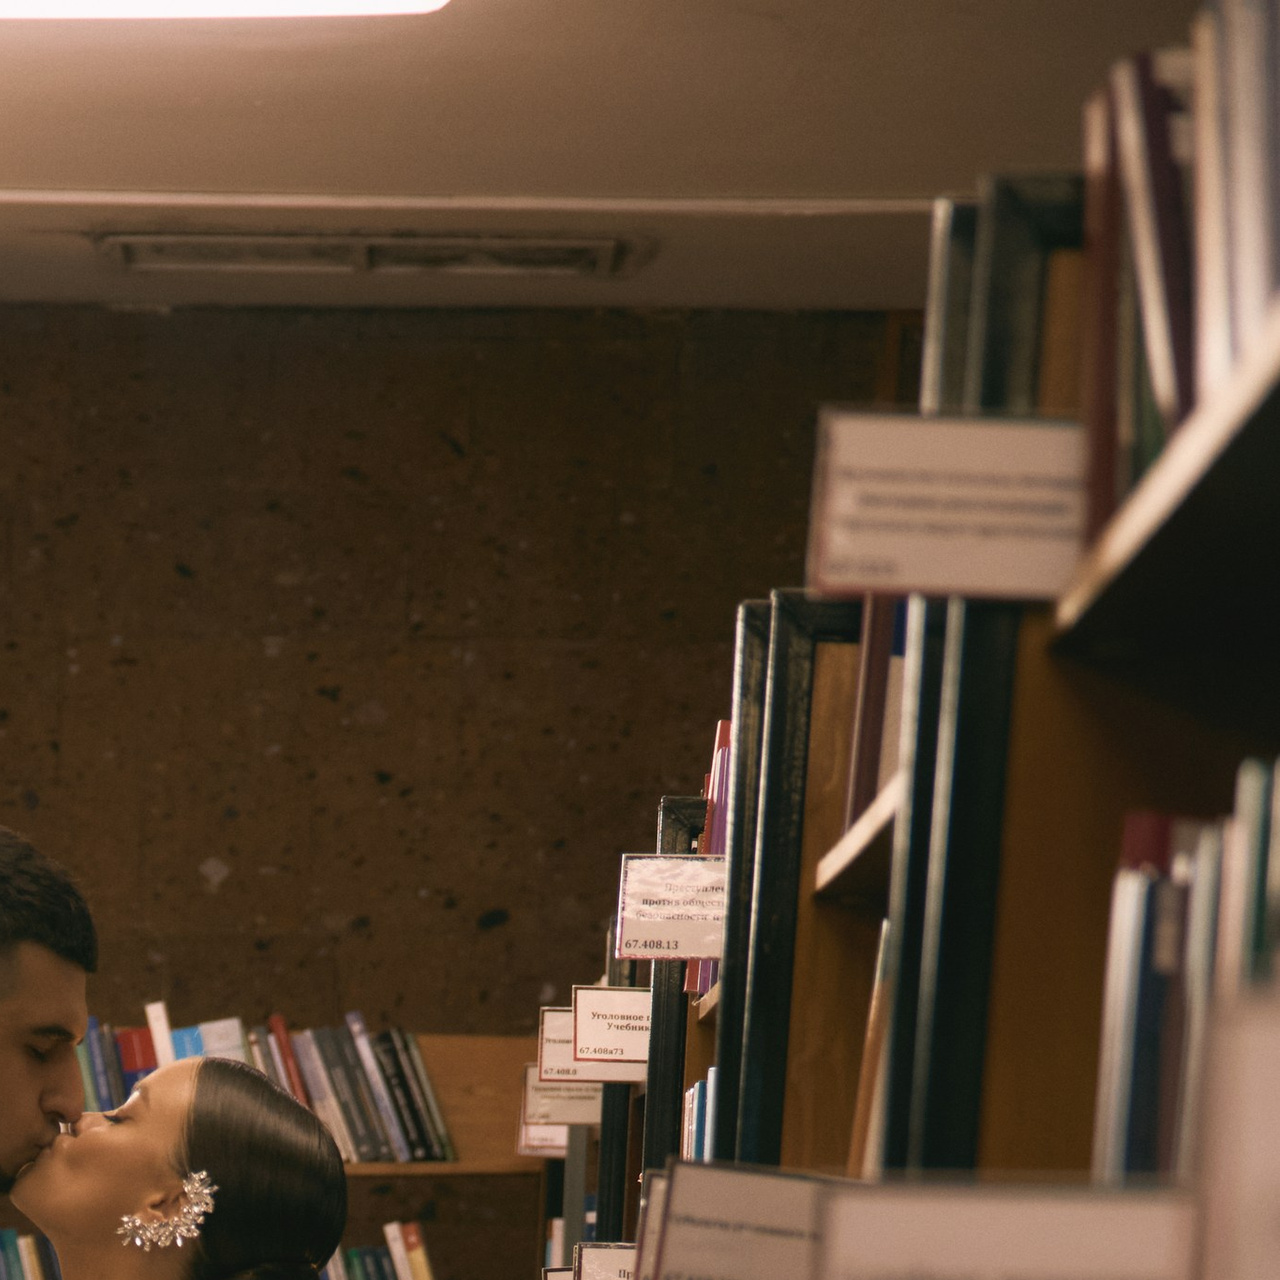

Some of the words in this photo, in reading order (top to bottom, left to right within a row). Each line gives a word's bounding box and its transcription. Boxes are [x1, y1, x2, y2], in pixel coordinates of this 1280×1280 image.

[642, 898, 680, 907] против
[636, 910, 708, 922] безопасности
[624, 939, 679, 950] 67.408.13
[591, 1011, 644, 1022] Уголовное
